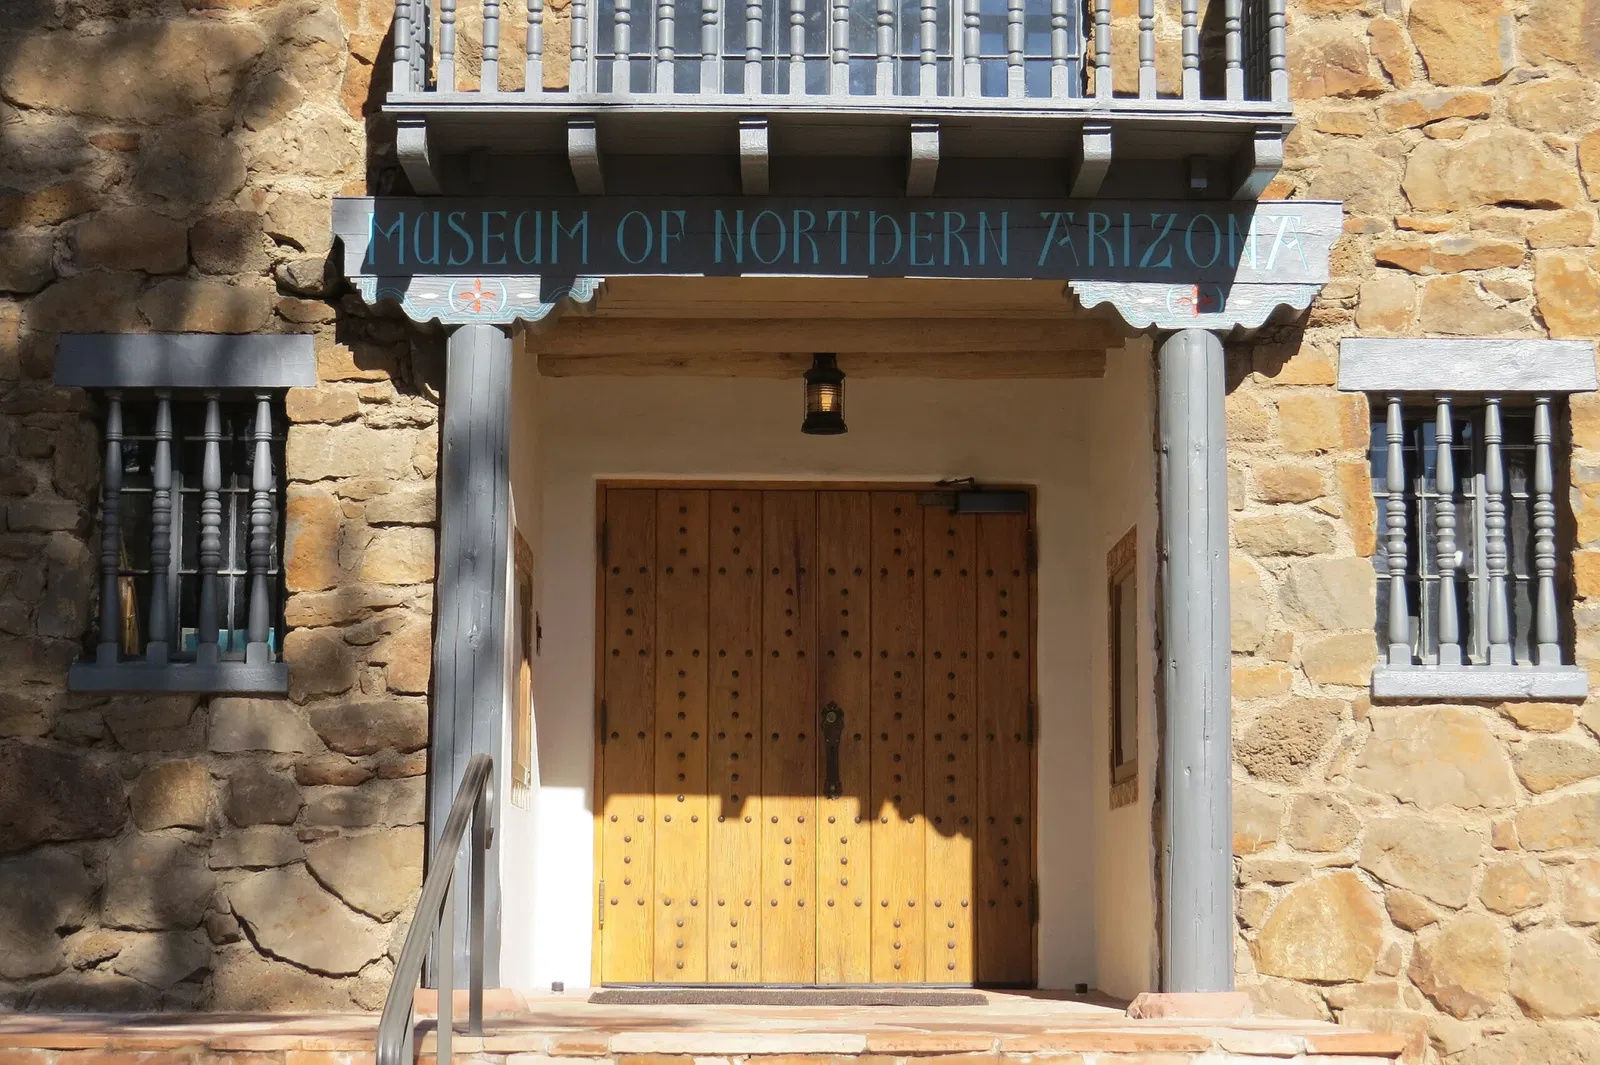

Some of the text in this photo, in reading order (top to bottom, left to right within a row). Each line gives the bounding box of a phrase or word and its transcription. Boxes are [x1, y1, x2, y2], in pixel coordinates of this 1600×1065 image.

[367, 209, 1310, 271] MUSEUM OF NORTHERN ARIZONA
